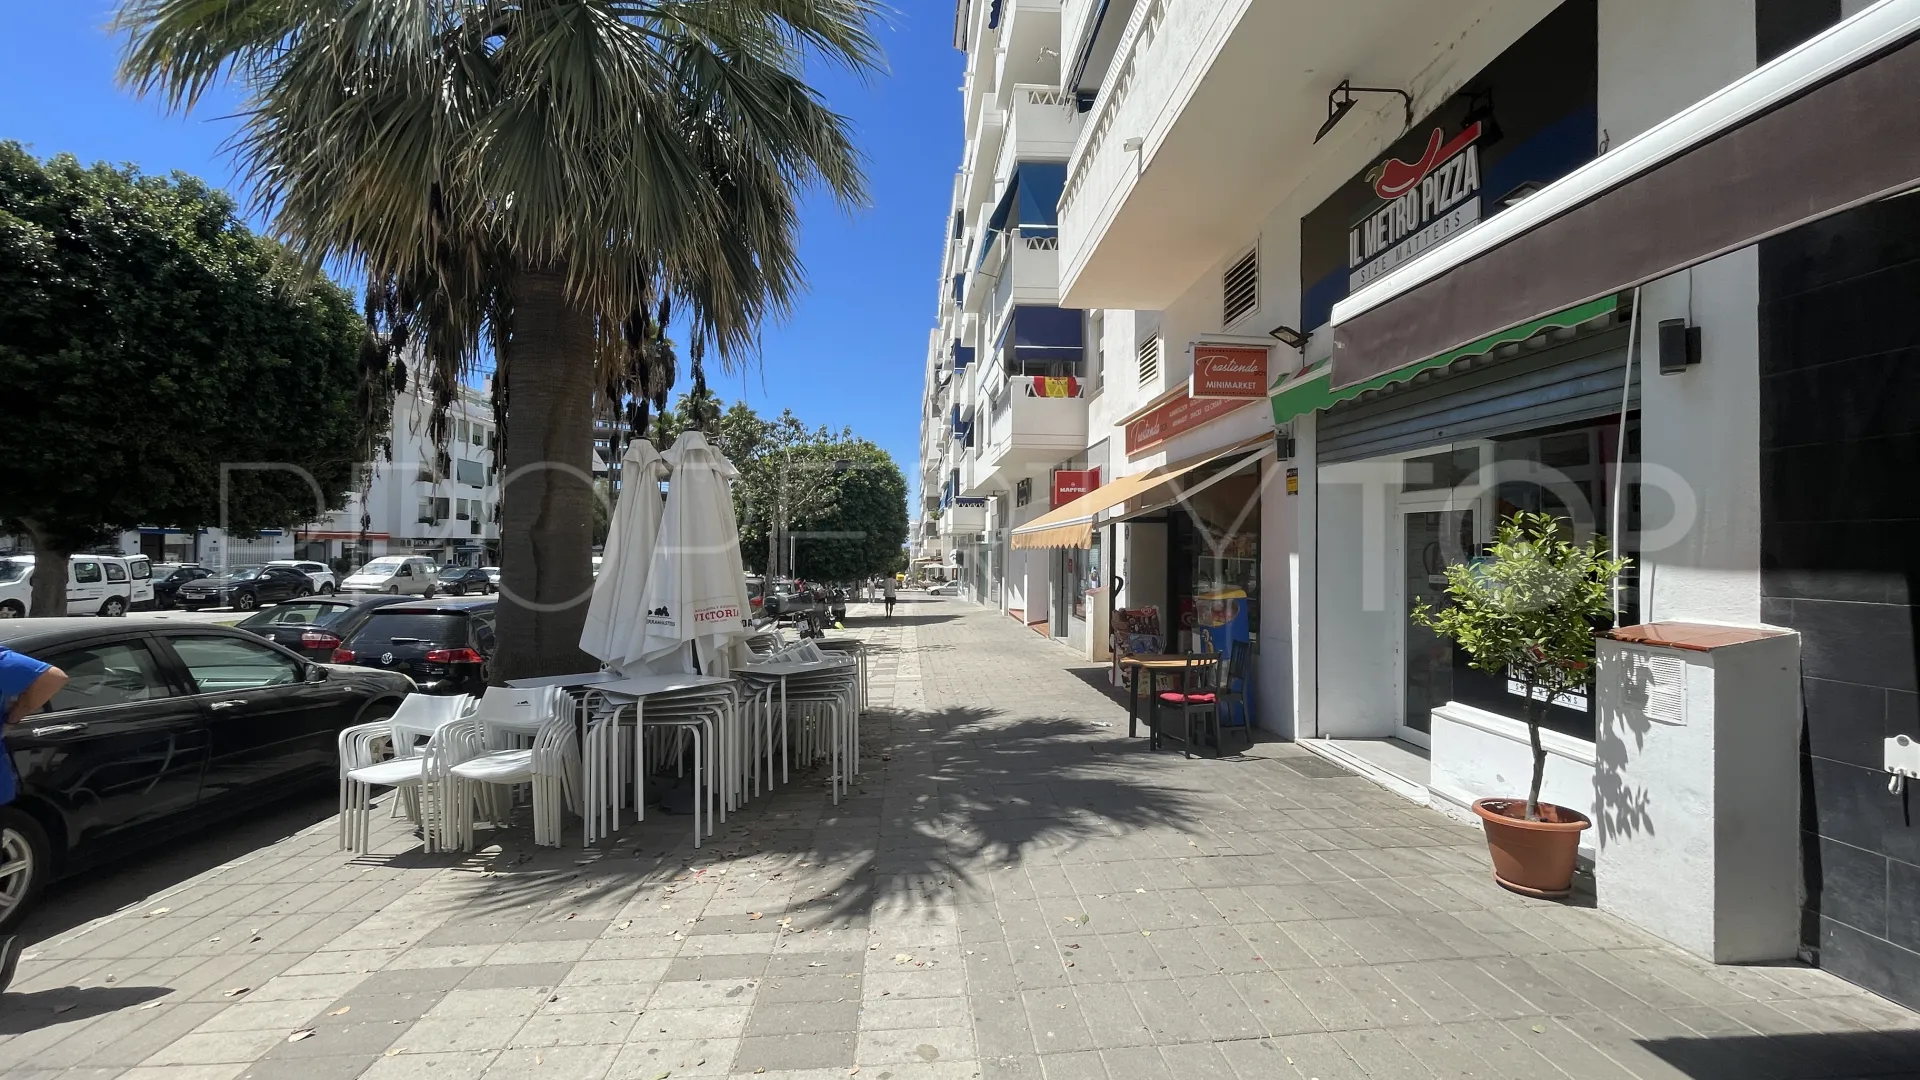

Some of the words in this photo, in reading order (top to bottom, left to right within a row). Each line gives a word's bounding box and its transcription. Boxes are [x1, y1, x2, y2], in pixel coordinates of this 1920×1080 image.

[1350, 228, 1363, 269] IL
[1364, 187, 1420, 259] METRO
[1422, 145, 1480, 223] PIZZA
[1360, 257, 1388, 283] SIZE
[1395, 211, 1461, 262] MATTERS
[1196, 355, 1259, 377] Trastienda
[1206, 381, 1257, 390] MINIMARKET
